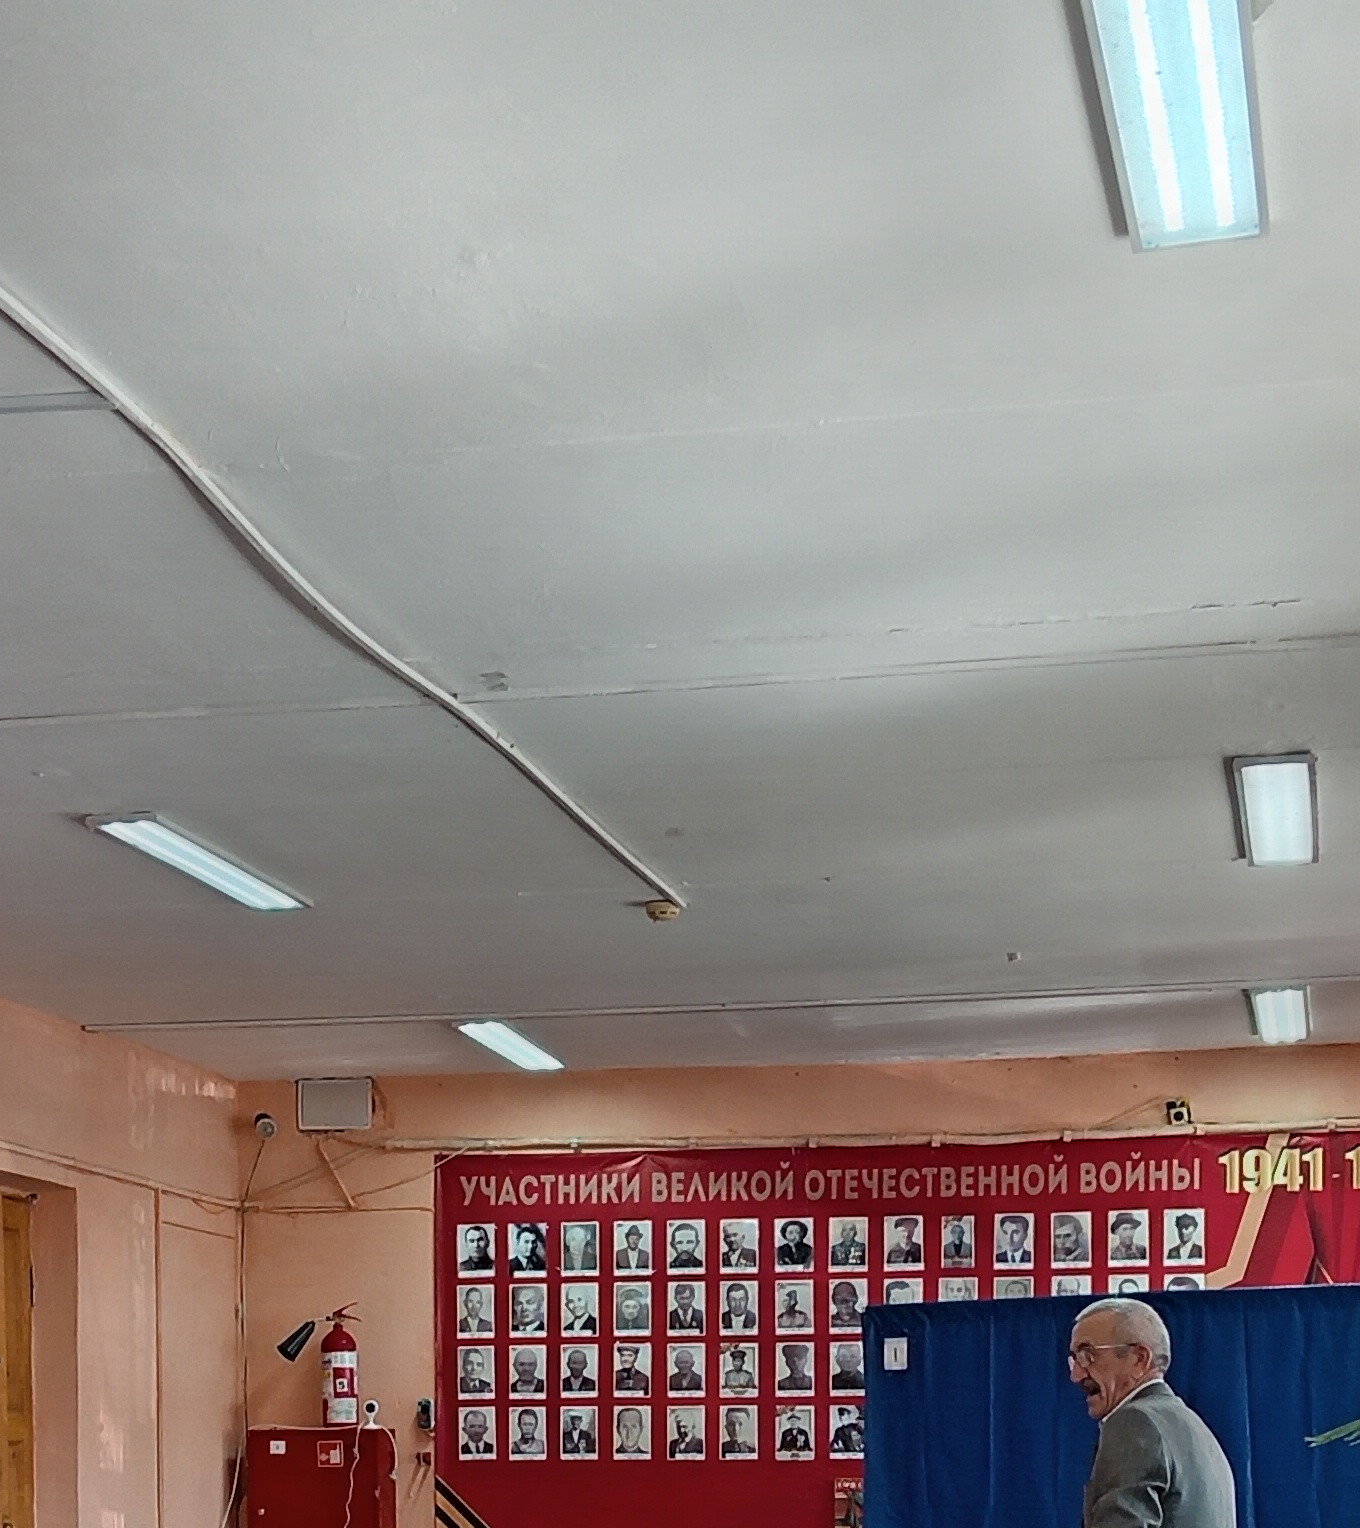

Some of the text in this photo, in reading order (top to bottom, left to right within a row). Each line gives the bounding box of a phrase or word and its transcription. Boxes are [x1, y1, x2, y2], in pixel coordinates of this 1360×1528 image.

[460, 1151, 1201, 1207] УЧАСТНИКИ ВЕЛИКОЙ ОТЕЧЕСТВЕННОЙ ВОЙНЫ
[1218, 1147, 1324, 1194] 1941
